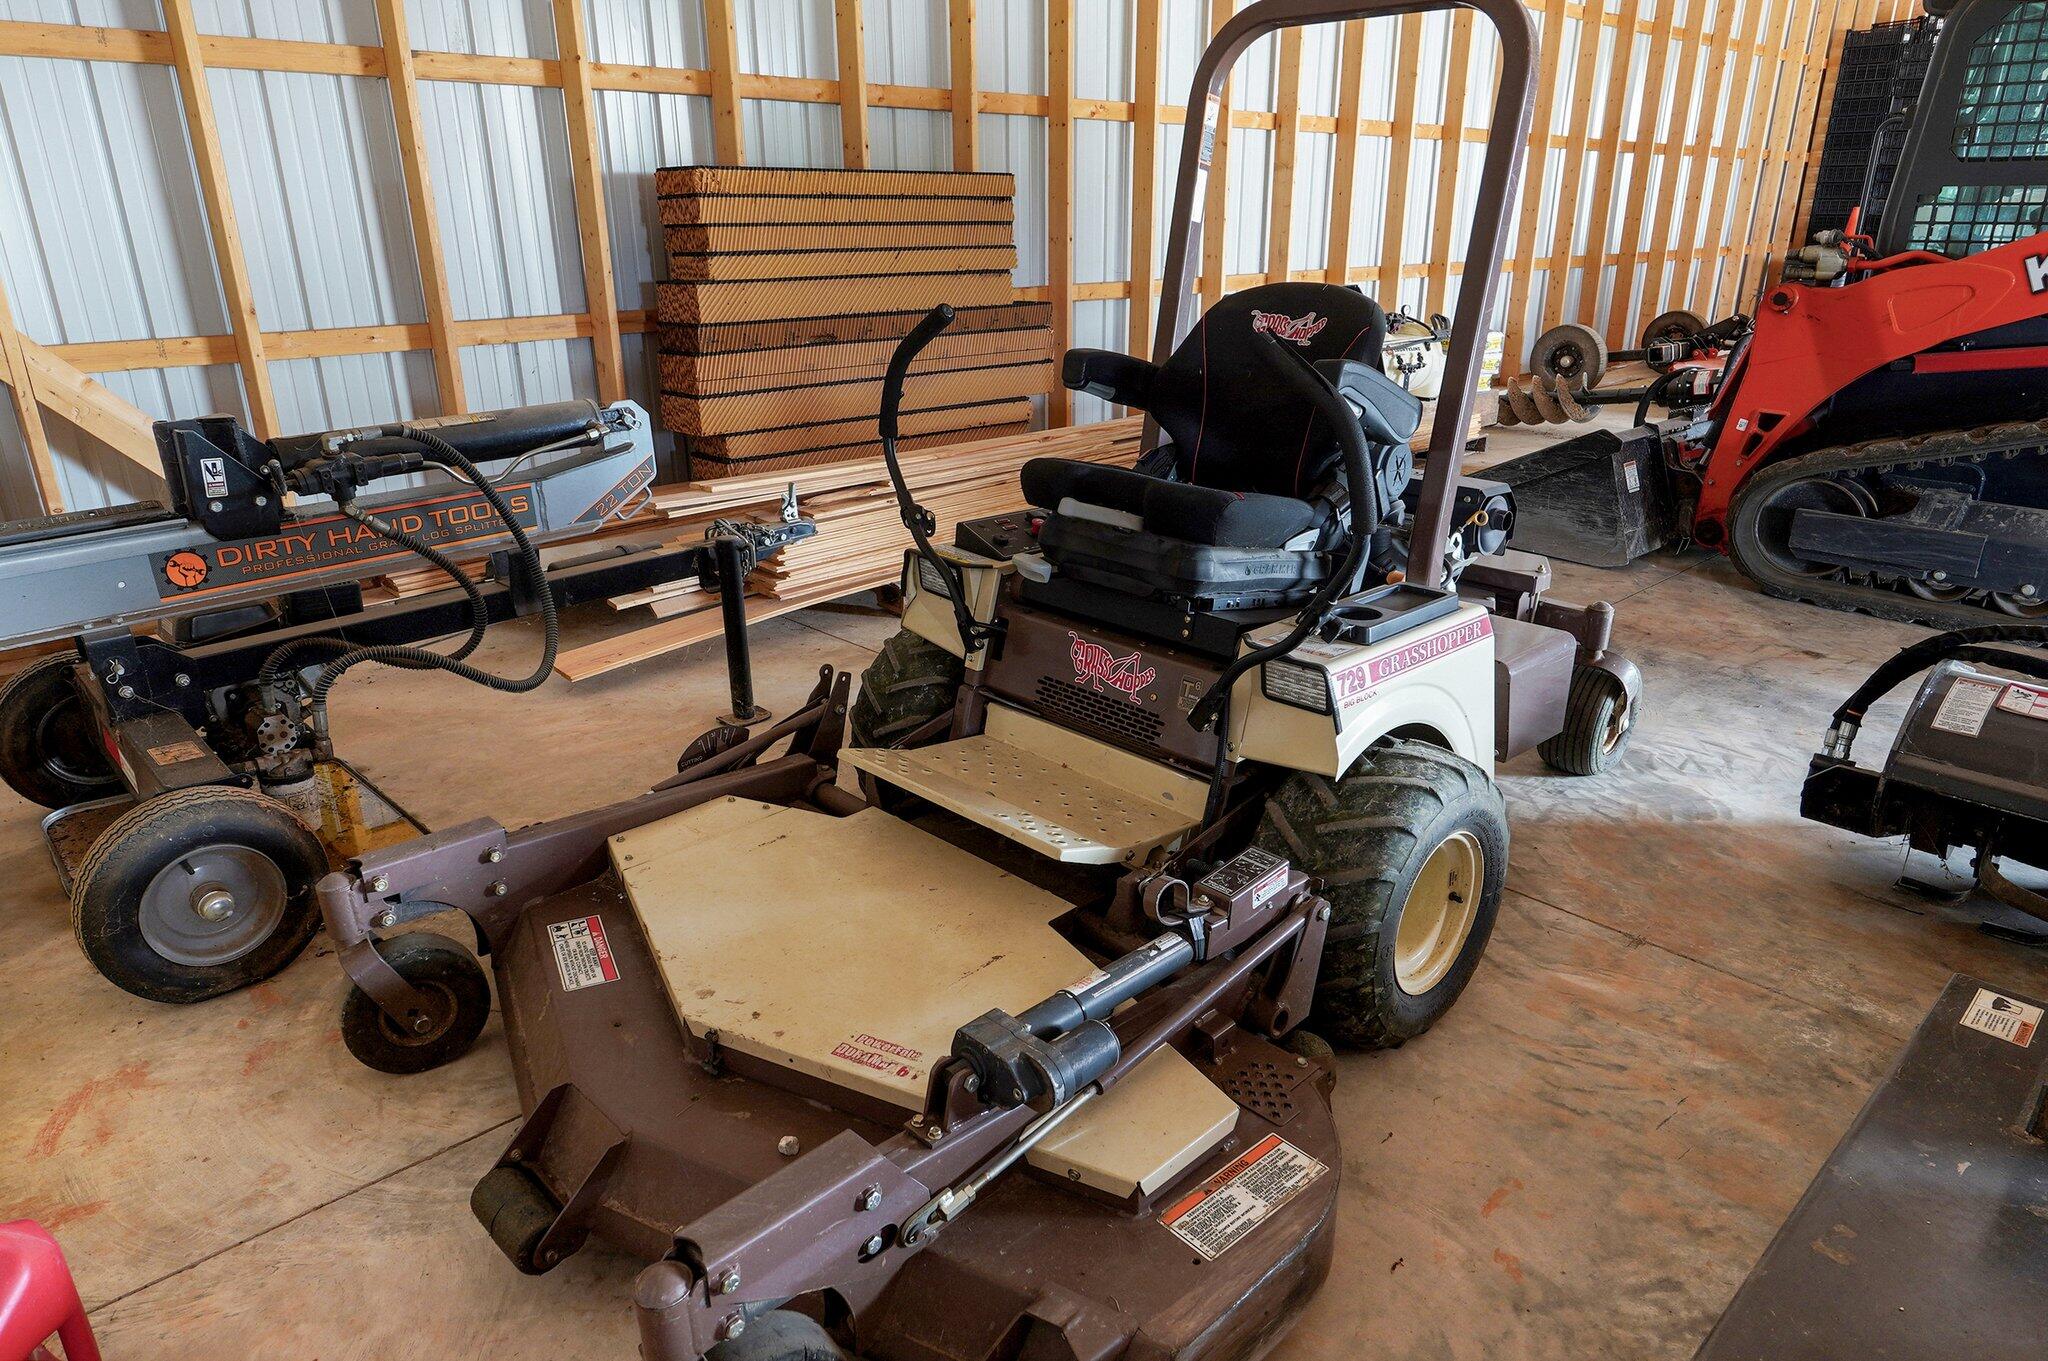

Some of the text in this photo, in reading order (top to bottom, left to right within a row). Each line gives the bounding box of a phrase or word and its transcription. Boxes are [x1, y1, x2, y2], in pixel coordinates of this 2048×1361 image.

[595, 464, 655, 516] 22 TON
[215, 530, 318, 568] DIRTY
[427, 494, 530, 528] TOOS
[241, 546, 364, 575] PROFESSIONAL
[422, 529, 450, 542] LOG
[455, 519, 507, 536] SPLITTE
[1335, 669, 1368, 698] 729
[1376, 620, 1483, 680] GRASSHOPPER
[1343, 690, 1379, 710] BIG BLOCK
[594, 936, 609, 960] DANGER
[1211, 1158, 1250, 1186] WARNING
